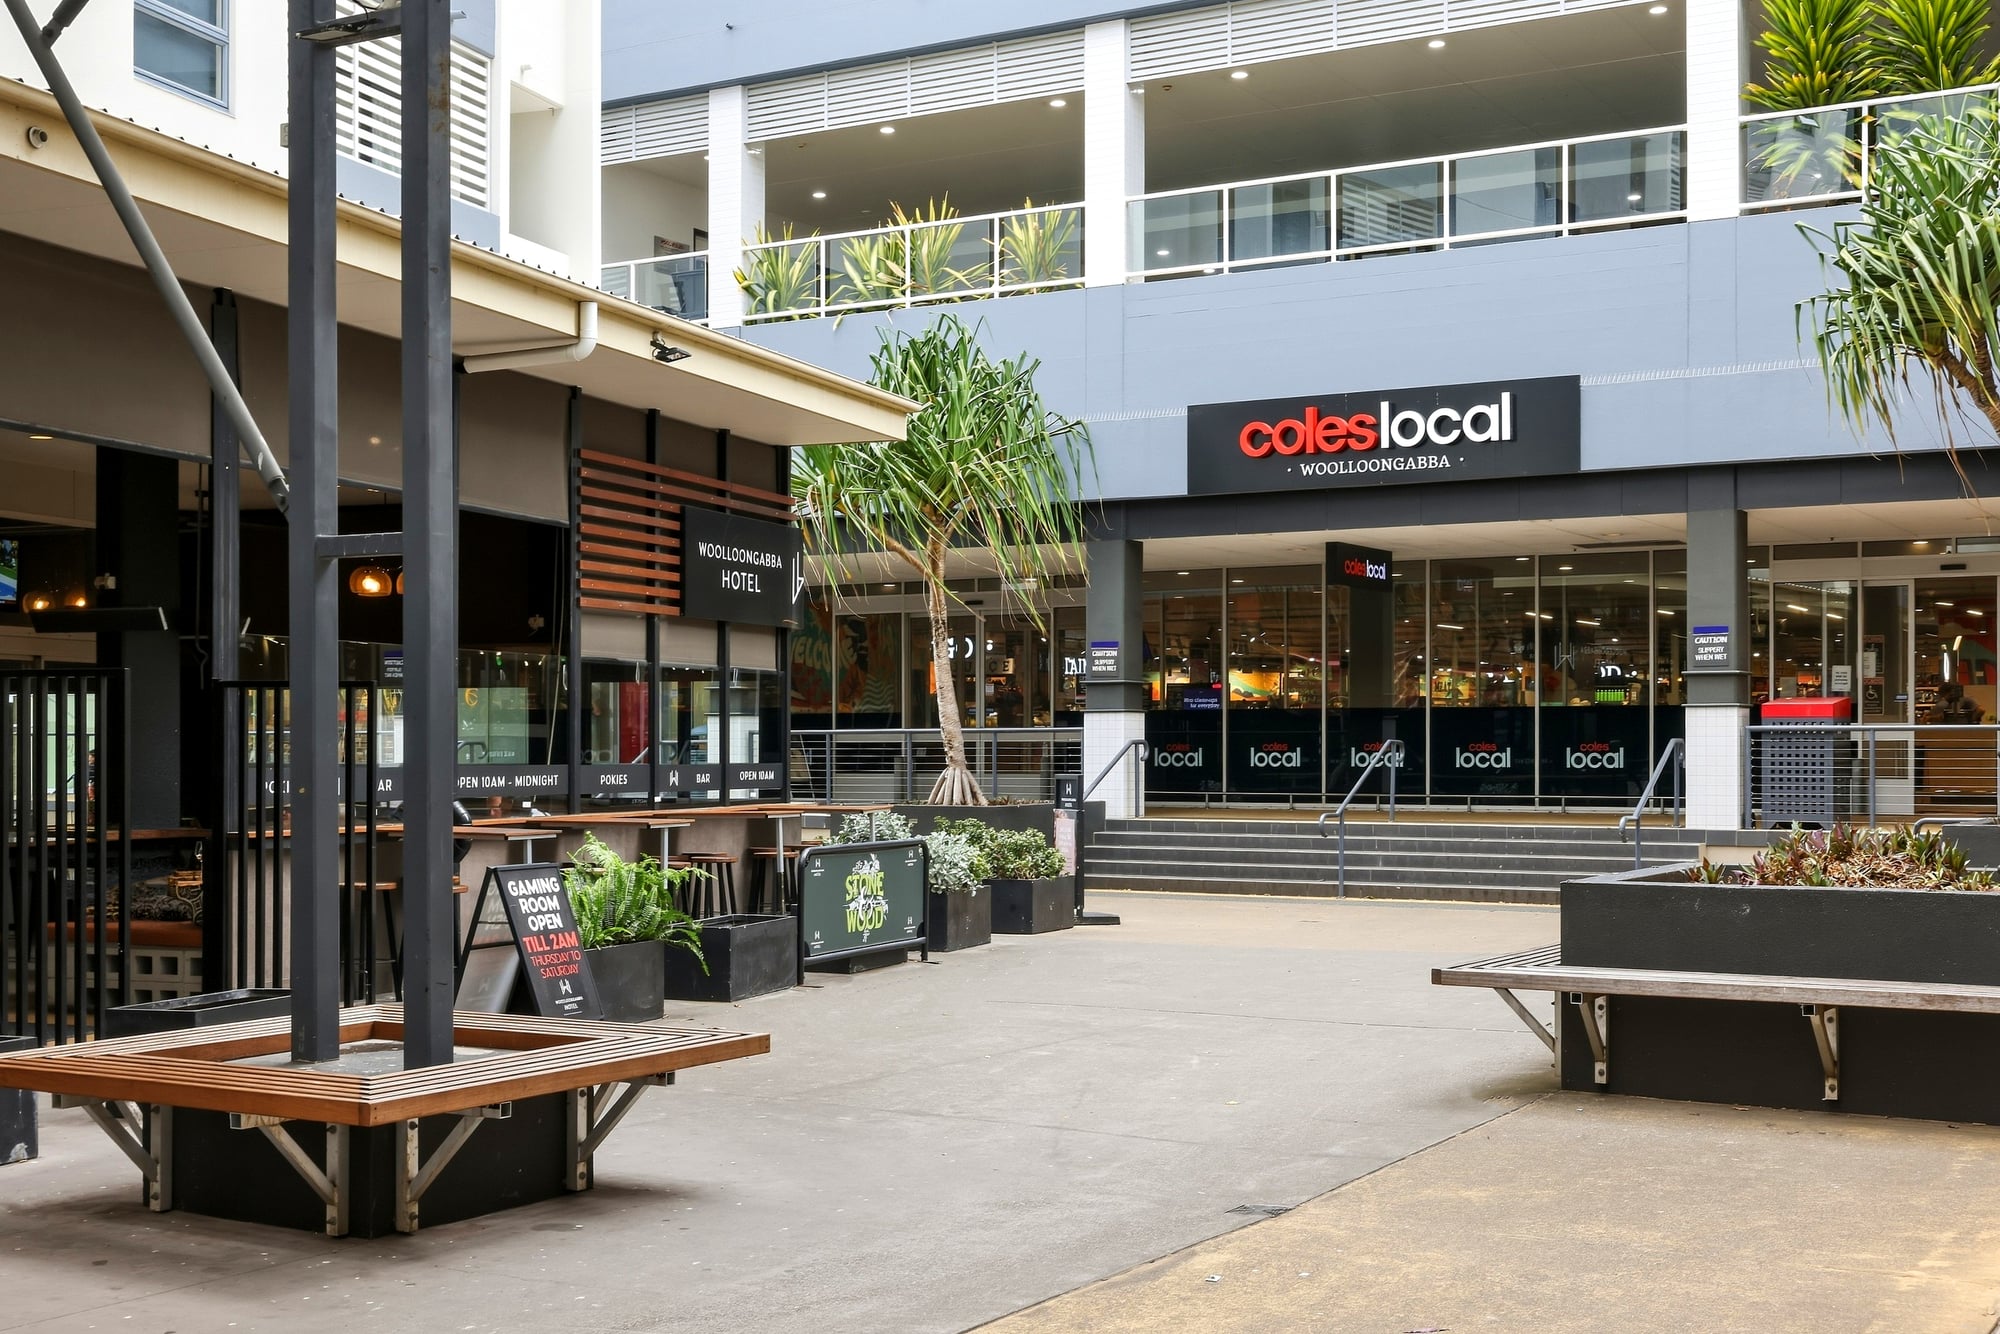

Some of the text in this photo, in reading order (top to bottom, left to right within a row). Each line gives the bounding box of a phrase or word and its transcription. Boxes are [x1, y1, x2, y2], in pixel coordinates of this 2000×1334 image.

[1300, 454, 1451, 477] WOOLLOONGABBA
[698, 541, 783, 569] WOOLLOONGABBA
[722, 569, 761, 593] HOTEL
[1694, 636, 1728, 644] CAUTION
[1166, 742, 1191, 751] coles
[1262, 742, 1288, 751] coles
[1468, 741, 1497, 751] coles
[1579, 741, 1609, 751] coles
[1154, 747, 1203, 767] local
[1250, 747, 1301, 767] local
[1455, 747, 1511, 768] local
[1566, 747, 1624, 769] local
[376, 779, 393, 792] AR
[481, 775, 506, 788] 10AM
[514, 774, 559, 787] MIDNIGHT
[600, 774, 628, 785] POKIES
[696, 773, 711, 784] BAR
[739, 771, 775, 781] OPEN 10AM
[507, 877, 560, 897] GAMING
[845, 871, 885, 902] STONE
[518, 895, 560, 914] ROOM
[527, 912, 563, 932] OPEN
[845, 906, 884, 933] WOOD
[522, 931, 579, 953] TILL 2AM
[530, 950, 582, 967] THURSDAY TO
[540, 964, 580, 979] SATURDAY
